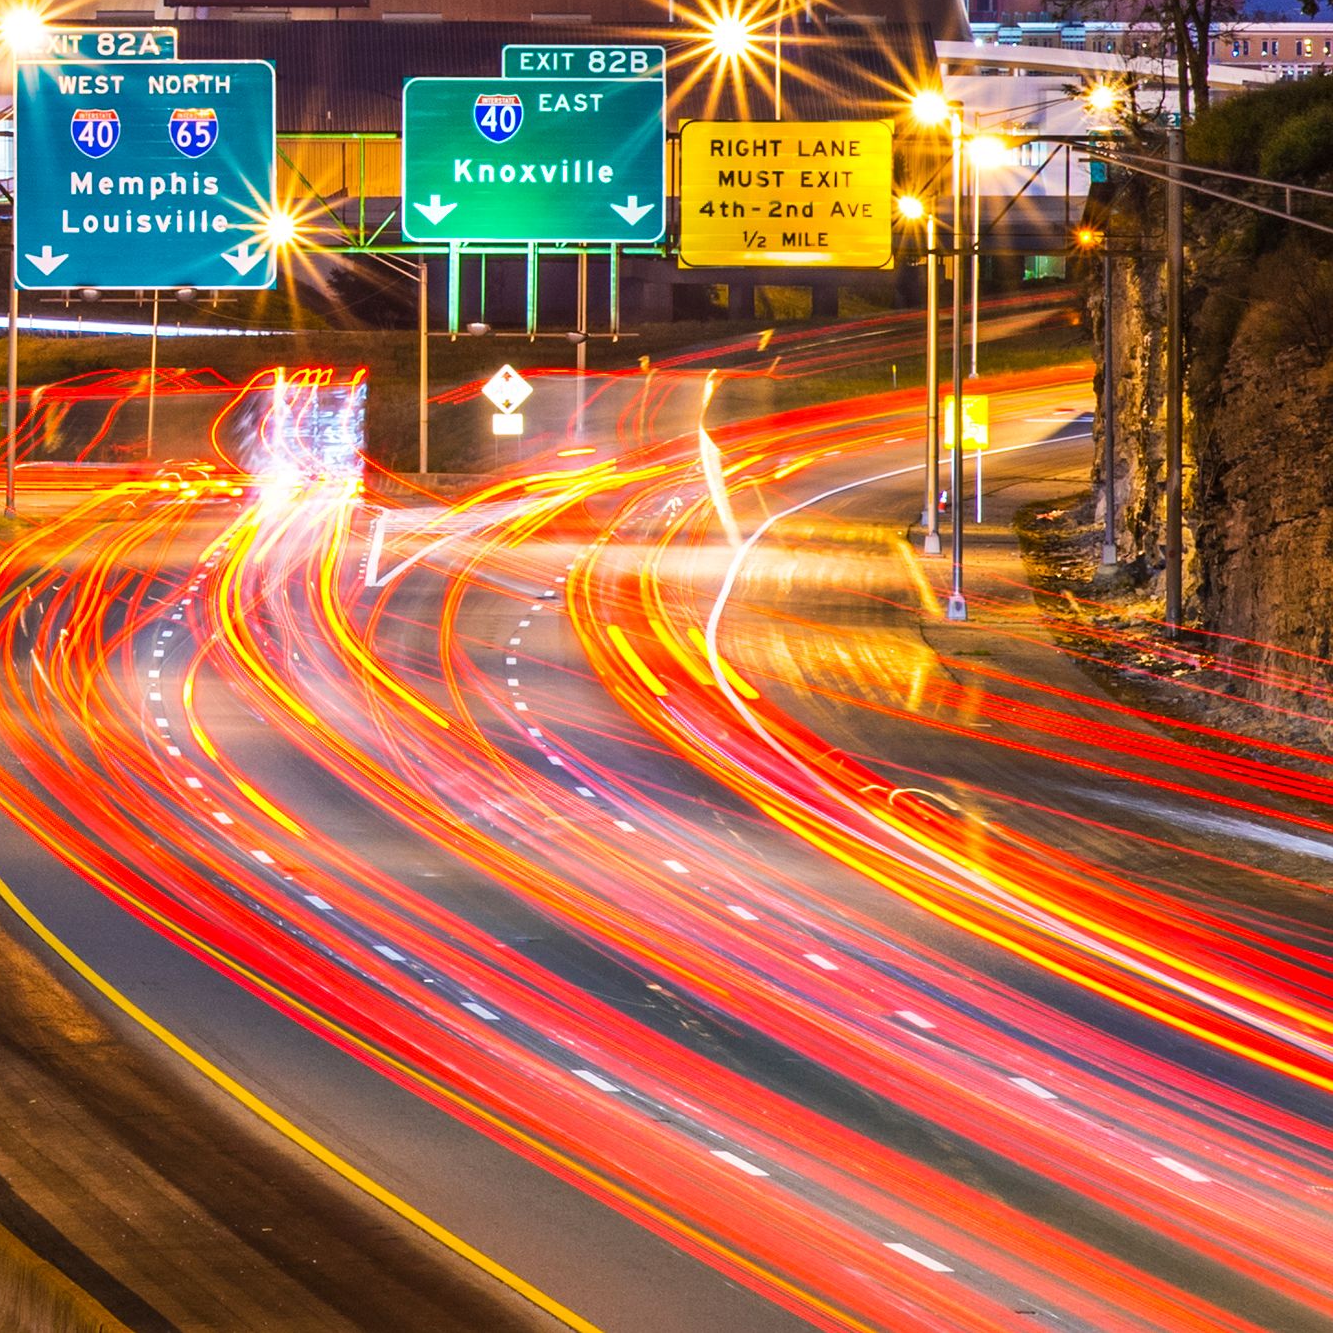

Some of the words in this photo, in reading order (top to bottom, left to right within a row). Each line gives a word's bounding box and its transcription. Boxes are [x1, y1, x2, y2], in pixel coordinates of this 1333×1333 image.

[96, 33, 160, 56] 82A
[520, 52, 575, 70] EXIT
[588, 50, 649, 73] 82B
[58, 75, 124, 94] WEST
[148, 74, 231, 94] NORTH
[538, 93, 604, 112] EAST
[480, 105, 516, 133] 40
[78, 121, 113, 148] 40
[176, 121, 211, 148] 65
[710, 139, 782, 157] RIGHT
[798, 140, 861, 157] LANE
[454, 158, 614, 183] Knoxville
[718, 171, 785, 188] MUST
[800, 171, 853, 188] EXIT
[70, 171, 219, 200] Memphis
[62, 209, 228, 233] Louisville
[830, 201, 873, 218] AVE
[782, 233, 829, 247] MILE
